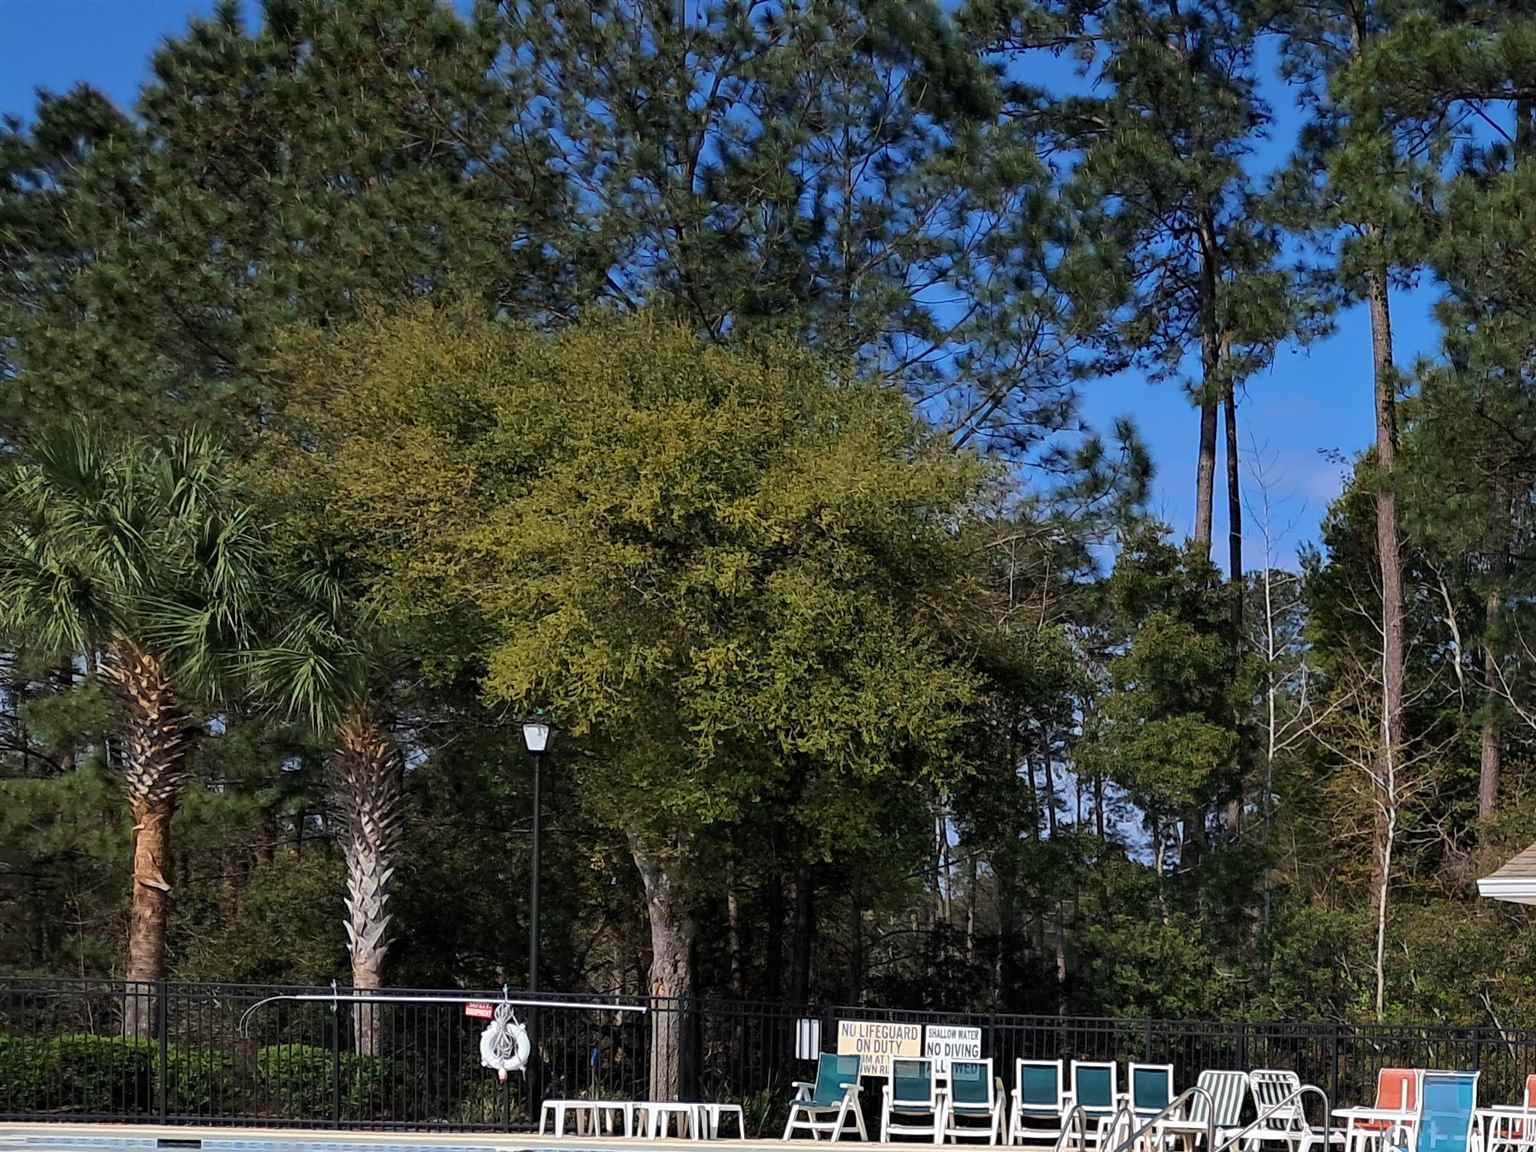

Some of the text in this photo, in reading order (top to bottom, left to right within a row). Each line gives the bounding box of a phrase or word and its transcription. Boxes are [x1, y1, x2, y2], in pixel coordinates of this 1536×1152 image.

[841, 1023, 918, 1040] NO LIFEGUARD
[928, 1028, 979, 1041] SHALLOW WATER
[856, 1038, 902, 1054] ON DUTY
[927, 1042, 979, 1058] NO DIVING
